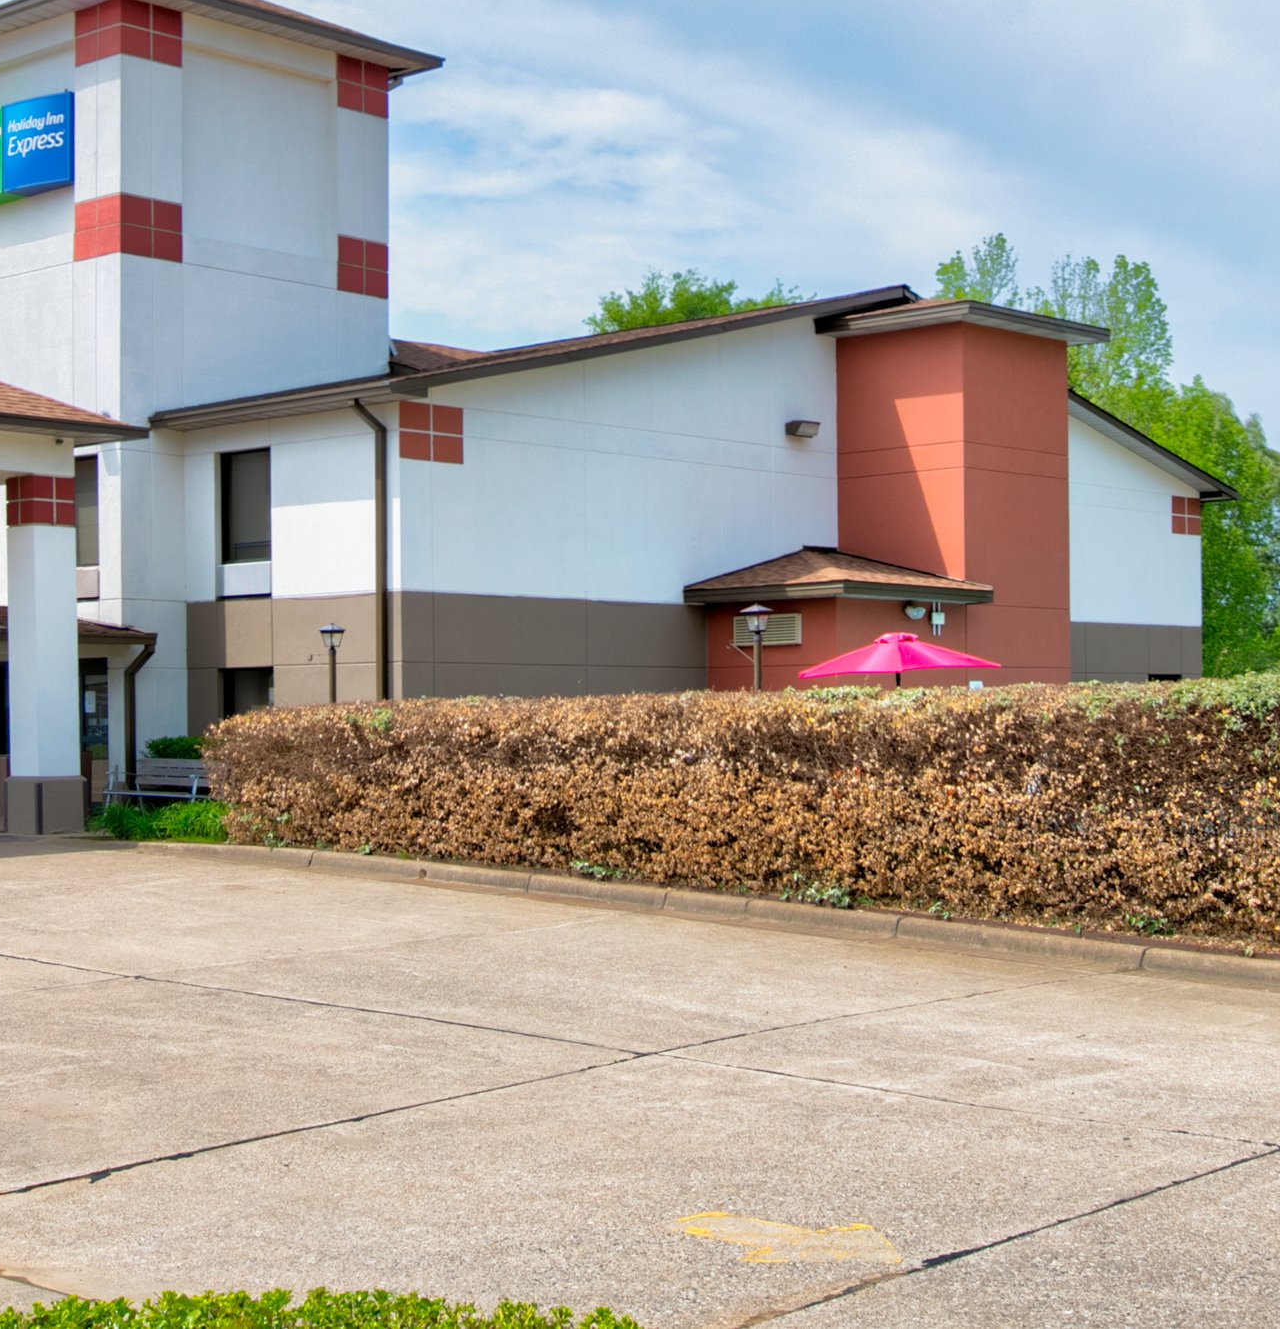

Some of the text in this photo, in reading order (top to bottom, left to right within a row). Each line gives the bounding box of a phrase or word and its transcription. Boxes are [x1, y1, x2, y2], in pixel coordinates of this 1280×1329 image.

[7, 111, 65, 133] Holiday Inn
[7, 131, 65, 158] Express
